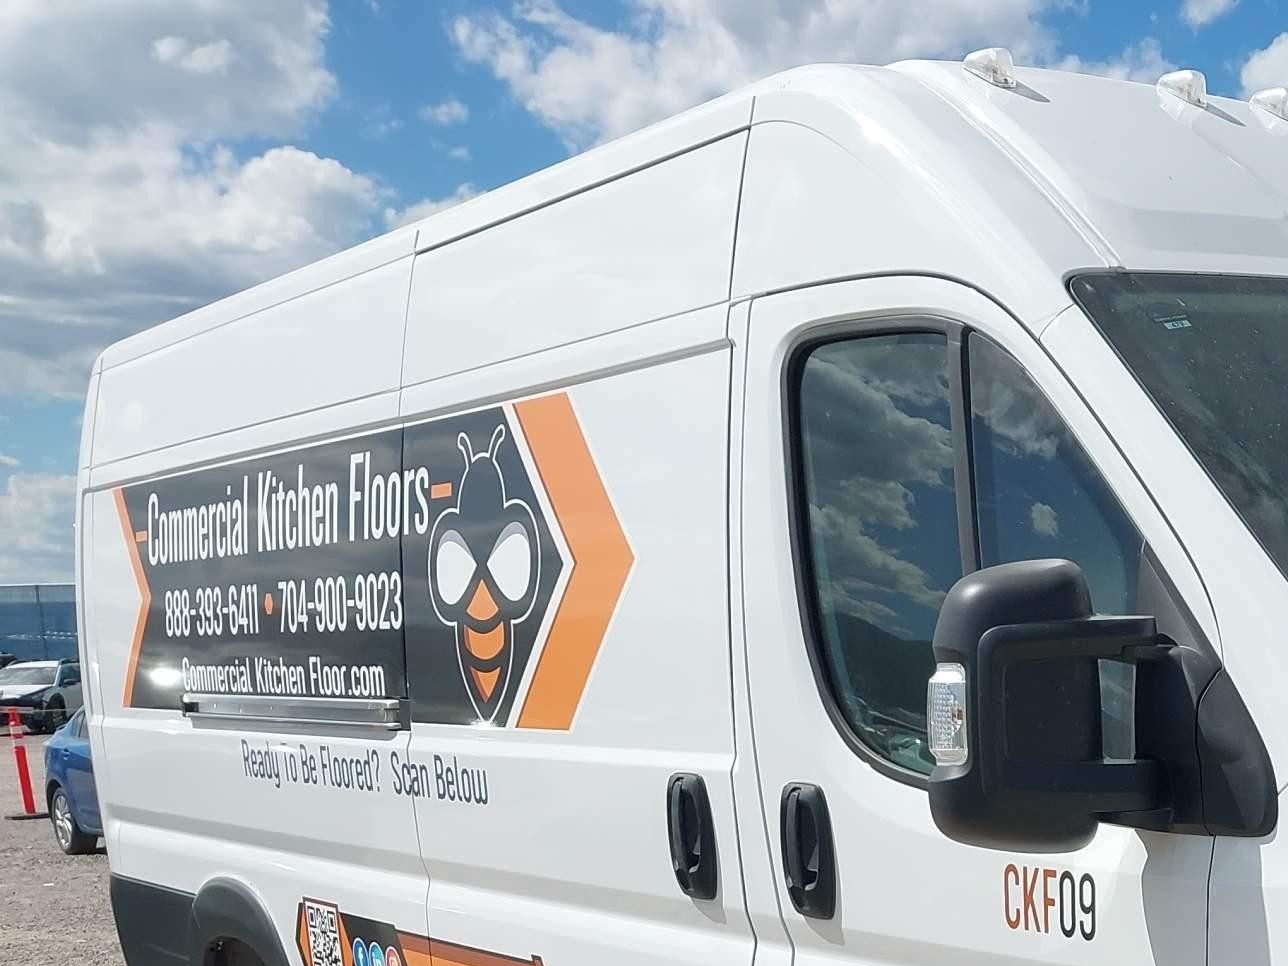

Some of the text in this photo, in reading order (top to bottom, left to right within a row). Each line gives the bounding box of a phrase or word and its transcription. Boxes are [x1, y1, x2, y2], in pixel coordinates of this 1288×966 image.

[148, 450, 429, 566] Commercial Kitchen Floors
[165, 571, 402, 637] 888-393-6411 704-900-9023
[182, 655, 386, 697] Commercial Kitchen Floor.com
[241, 739, 281, 789] Ready
[299, 743, 318, 785] Be
[319, 745, 381, 793] Floored?
[390, 750, 431, 798] Scan
[434, 754, 489, 805] Below
[1003, 863, 1096, 942] CKF09
